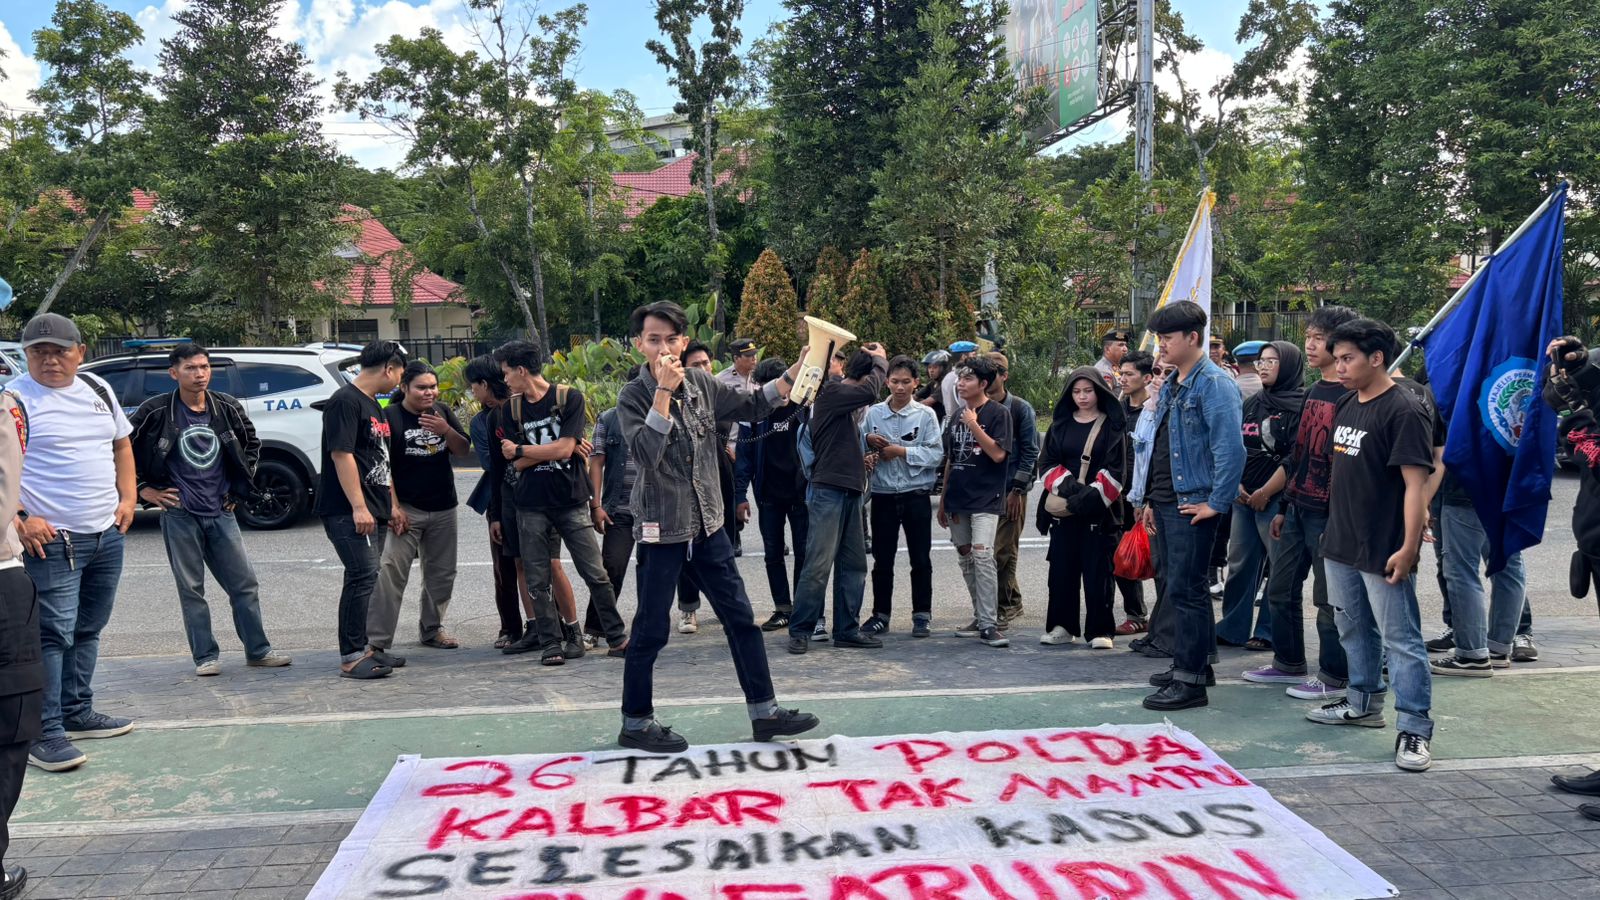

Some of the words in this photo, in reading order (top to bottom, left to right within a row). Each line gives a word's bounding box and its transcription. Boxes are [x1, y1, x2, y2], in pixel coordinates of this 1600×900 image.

[264, 398, 302, 411] TAA
[1490, 375, 1513, 403] MAJELIS
[1513, 371, 1536, 380] PERM
[421, 755, 585, 800] 26
[593, 743, 838, 785] TAHUN
[873, 731, 1204, 775] POLDA
[426, 789, 788, 851] KALBAR
[805, 777, 973, 812] TAK
[972, 802, 1267, 850] KASUS
